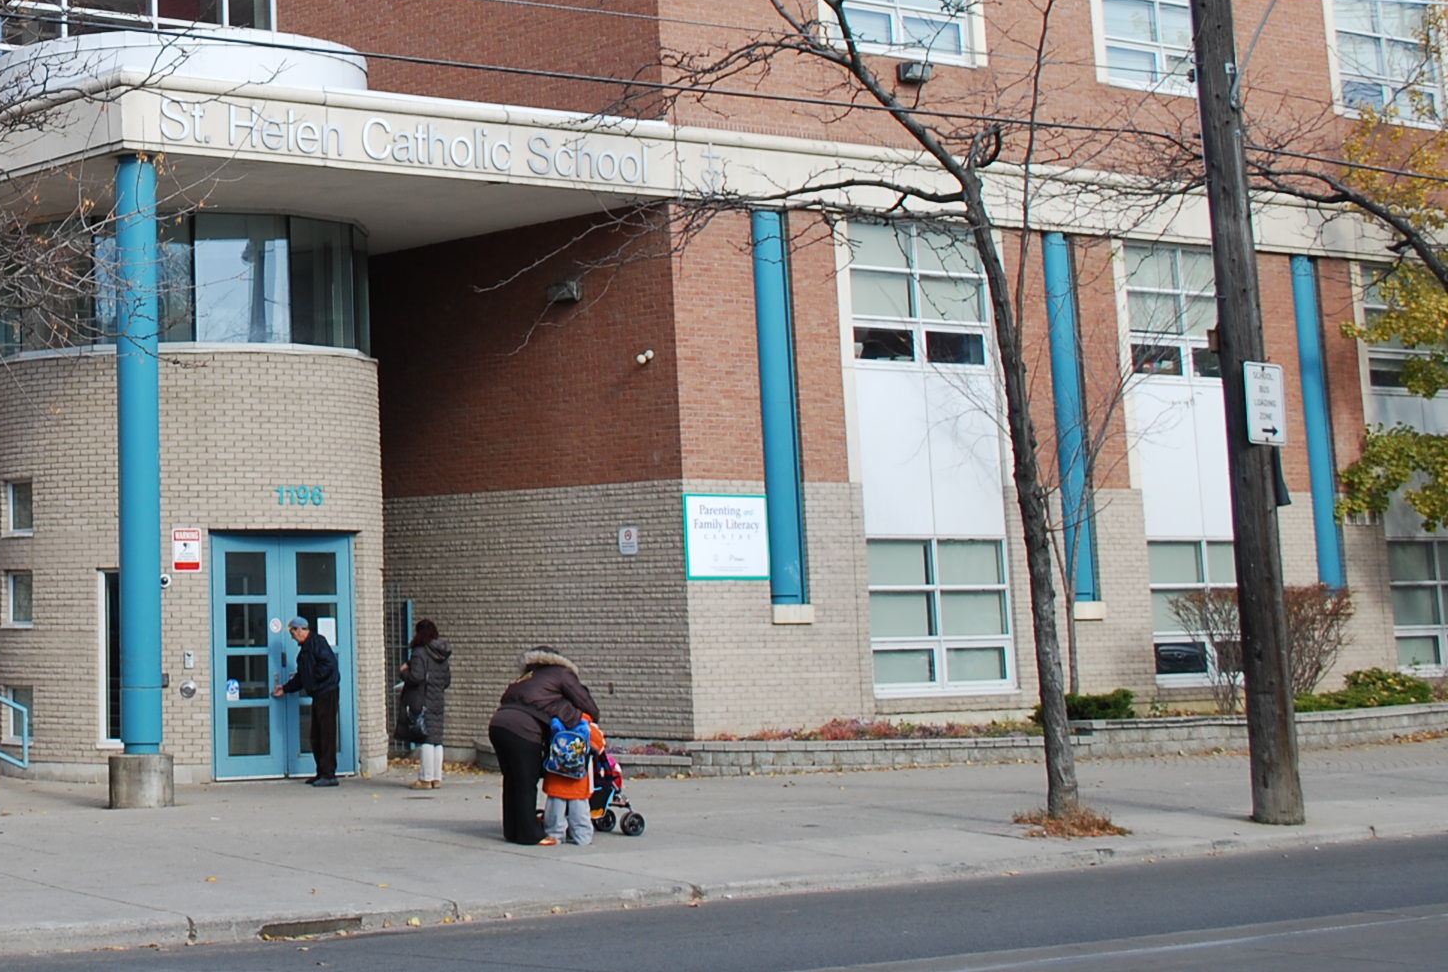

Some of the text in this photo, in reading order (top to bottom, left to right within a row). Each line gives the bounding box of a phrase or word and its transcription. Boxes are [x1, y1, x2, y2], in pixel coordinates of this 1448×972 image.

[160, 97, 649, 184] St. Helen Catholic School
[1254, 399, 1276, 407] LOADING
[1259, 412, 1272, 420] ZONE
[275, 484, 324, 506] 1196
[698, 504, 742, 519] Parenting
[693, 518, 760, 533] Family Literacy
